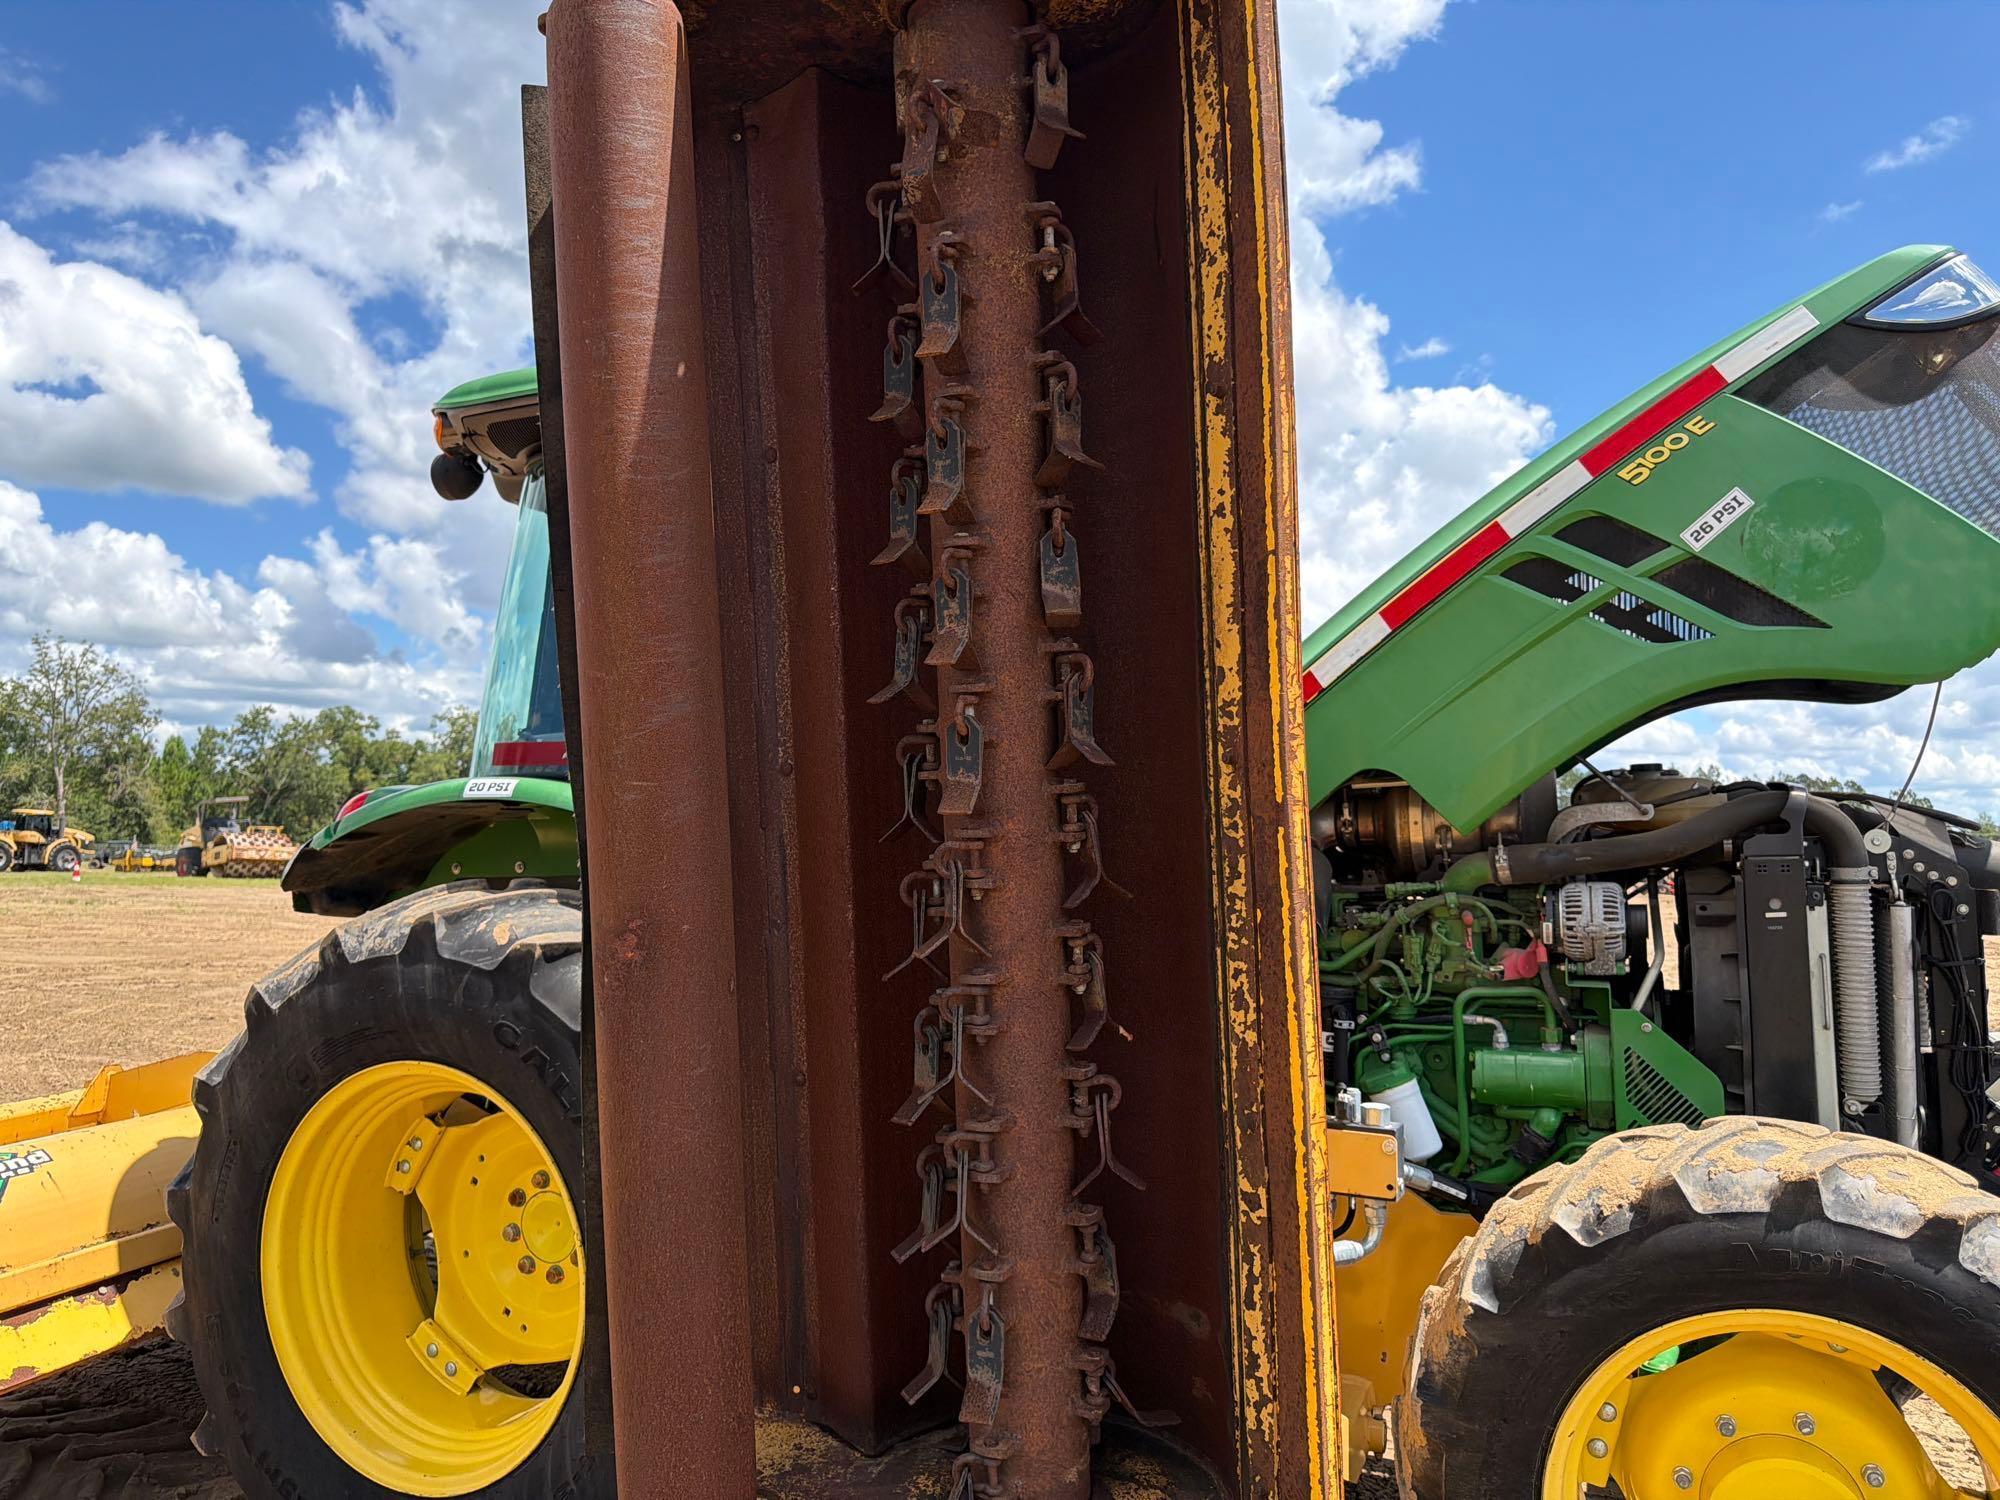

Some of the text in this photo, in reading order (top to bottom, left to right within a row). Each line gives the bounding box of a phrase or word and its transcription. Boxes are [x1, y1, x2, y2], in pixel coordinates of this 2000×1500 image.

[1617, 415, 1717, 486] 5100 E
[1690, 495, 1745, 543] 26 PSI
[469, 783, 511, 791] 20 PSI
